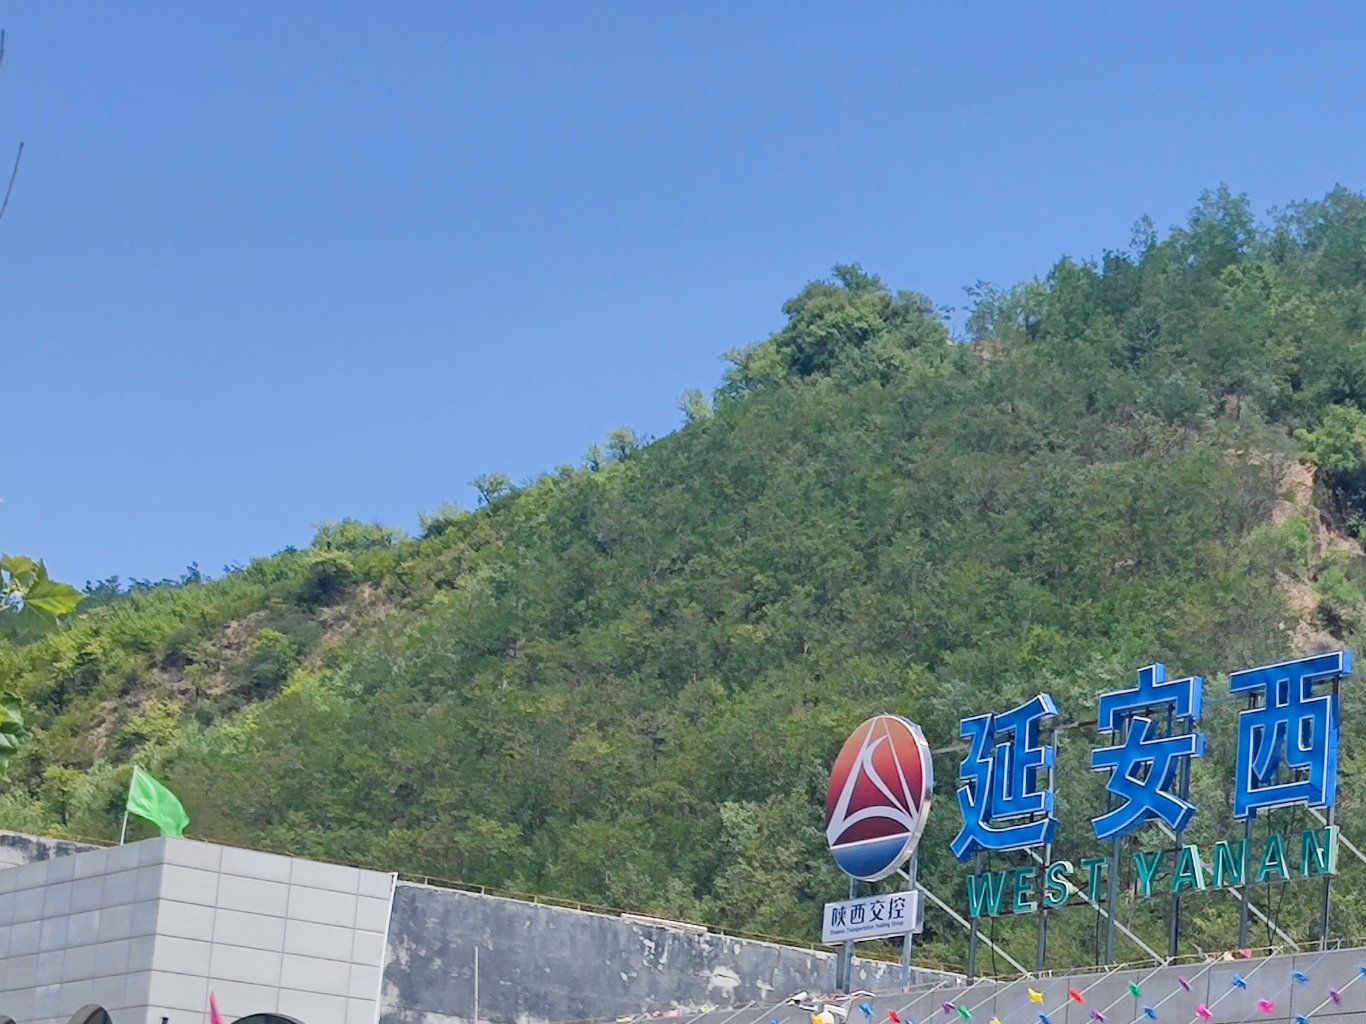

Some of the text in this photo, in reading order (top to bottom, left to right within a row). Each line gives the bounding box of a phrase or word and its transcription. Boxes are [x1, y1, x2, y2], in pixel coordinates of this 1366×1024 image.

[967, 858, 1109, 918] WEST
[1135, 827, 1340, 899] YANAN
[831, 897, 906, 927] 陕西交控
